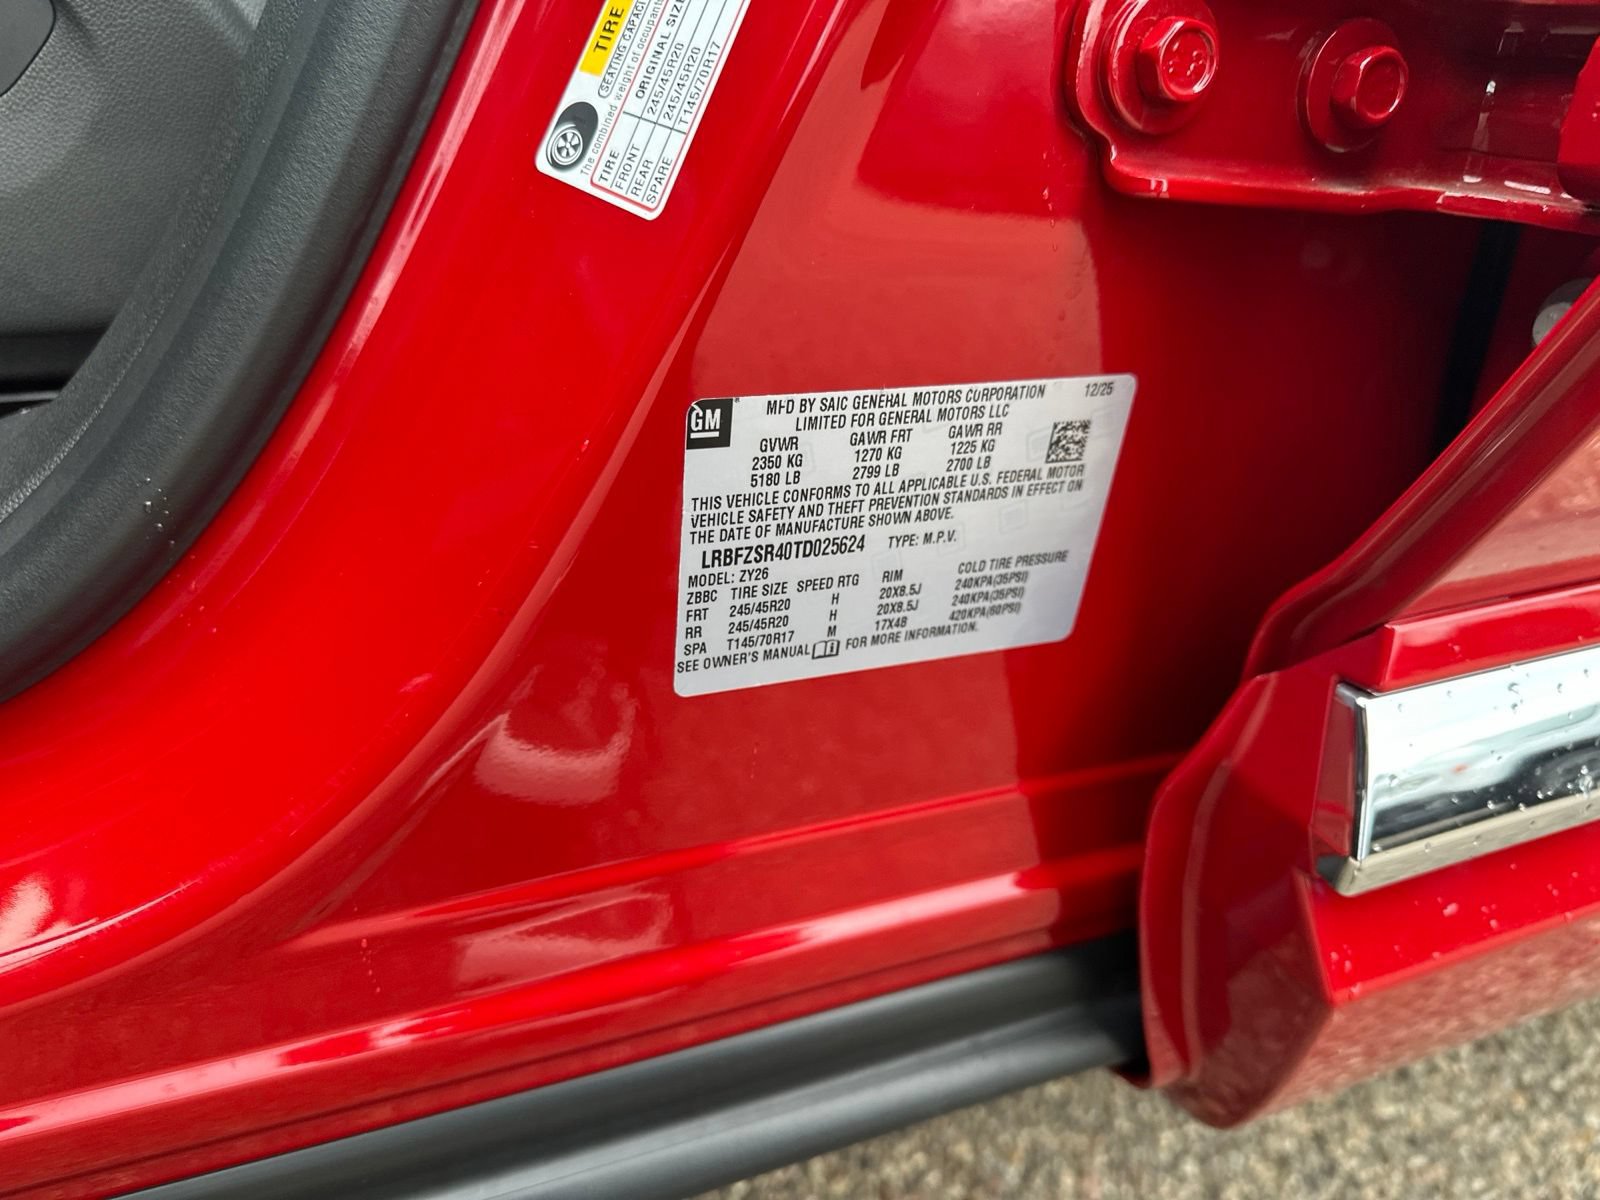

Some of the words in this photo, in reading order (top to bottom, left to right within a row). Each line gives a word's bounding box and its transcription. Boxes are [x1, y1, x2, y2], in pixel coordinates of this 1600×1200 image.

[593, 6, 624, 52] TIRE
[600, 46, 626, 92] SEATING
[636, 33, 671, 98] ORIGINAL
[647, 43, 684, 115] 245/45R20
[664, 47, 701, 122] 245/45R20
[680, 42, 721, 126] T145/70R17
[580, 158, 594, 175] The
[594, 105, 618, 155] combined
[615, 63, 635, 100] weight
[632, 48, 641, 61] of
[598, 151, 619, 181] TIRE
[615, 144, 640, 190] FRONT
[631, 159, 654, 197] REAR
[646, 156, 673, 203] SPARE
[800, 398, 816, 413] BY
[820, 396, 848, 411] SAIC
[853, 392, 907, 409] GENERAL
[913, 389, 962, 406] MOTORS
[965, 384, 1046, 403] CORPORATION
[1085, 382, 1115, 398] 12/25
[690, 408, 720, 431] GM
[796, 414, 846, 431] LIMITED
[851, 412, 874, 427] FOR
[879, 408, 931, 425] GENERAL
[937, 405, 985, 422] MOTORS
[989, 404, 1009, 418] LLC
[850, 431, 886, 447] GAWR
[891, 428, 913, 442] FRT
[948, 424, 983, 439] GAWR
[986, 422, 1003, 436] RR
[760, 437, 799, 453] GVWR
[950, 440, 977, 455] 1225
[980, 439, 995, 452] KG
[752, 454, 782, 471] 2350
[787, 454, 803, 467] KG
[855, 448, 882, 463] 1270
[887, 447, 902, 460] KG
[946, 458, 972, 472] 2700
[977, 456, 991, 469] LB
[750, 472, 780, 488] 5180
[786, 471, 800, 485] LB
[852, 465, 881, 480] 2799
[885, 464, 899, 477] LB
[692, 495, 722, 512] THIS
[727, 491, 779, 508] VEHICLE
[783, 485, 851, 503] CONFORMS
[855, 483, 870, 497] TO
[874, 481, 895, 495] ALL
[899, 478, 967, 493] APPLICABLE
[970, 473, 992, 486] U.S.
[997, 467, 1043, 484] FEDERAL
[1047, 464, 1085, 479] MOTOR
[691, 511, 744, 528] VEHICLE
[749, 506, 794, 524] SAFETY
[798, 504, 824, 519] AND
[828, 499, 865, 515] THEFT
[869, 494, 939, 508] PREVENTION
[943, 487, 1008, 504] STANDARDS
[1011, 485, 1023, 497] IN
[1027, 481, 1064, 497] EFFECT
[1068, 479, 1083, 492] ON
[690, 529, 714, 545] THE
[720, 526, 751, 542] DATE
[755, 524, 771, 538] OF
[775, 515, 864, 537] MANUFACTURE
[869, 511, 910, 524] SHOWN
[915, 507, 954, 522] ABOVE.
[888, 534, 919, 549] TYPE:
[923, 530, 957, 544] M.P.V.
[702, 534, 866, 568] LRBFZSR40TD025624
[958, 560, 985, 574] COLD
[990, 557, 1012, 571] TIRE
[1015, 551, 1069, 567] PRESSURE
[688, 573, 734, 588] MODEL:
[740, 567, 769, 582] ZY26
[797, 577, 834, 593] SPEED
[838, 574, 859, 588] RTG
[882, 569, 903, 583] RIM
[687, 590, 717, 605] ZBBC
[731, 585, 757, 600] TIRE
[762, 582, 788, 597] SIZE
[832, 593, 839, 606] H
[879, 583, 922, 599] 20X8.5J
[686, 608, 709, 623] FRT
[730, 599, 791, 618] 245/45R20
[829, 610, 837, 622] H
[877, 600, 919, 615] 20X8.5J
[685, 626, 702, 639] RR
[728, 615, 789, 635] 245/45R20
[827, 625, 837, 638] M
[677, 660, 699, 673] SEE
[704, 651, 758, 669] OWNER'S
[763, 644, 810, 661] MANUAL
[845, 637, 867, 650] FOR
[871, 631, 901, 646] MORE
[904, 622, 978, 641] INFORMATION.
[684, 642, 707, 656] SPA
[727, 631, 794, 651] T145/70R17
